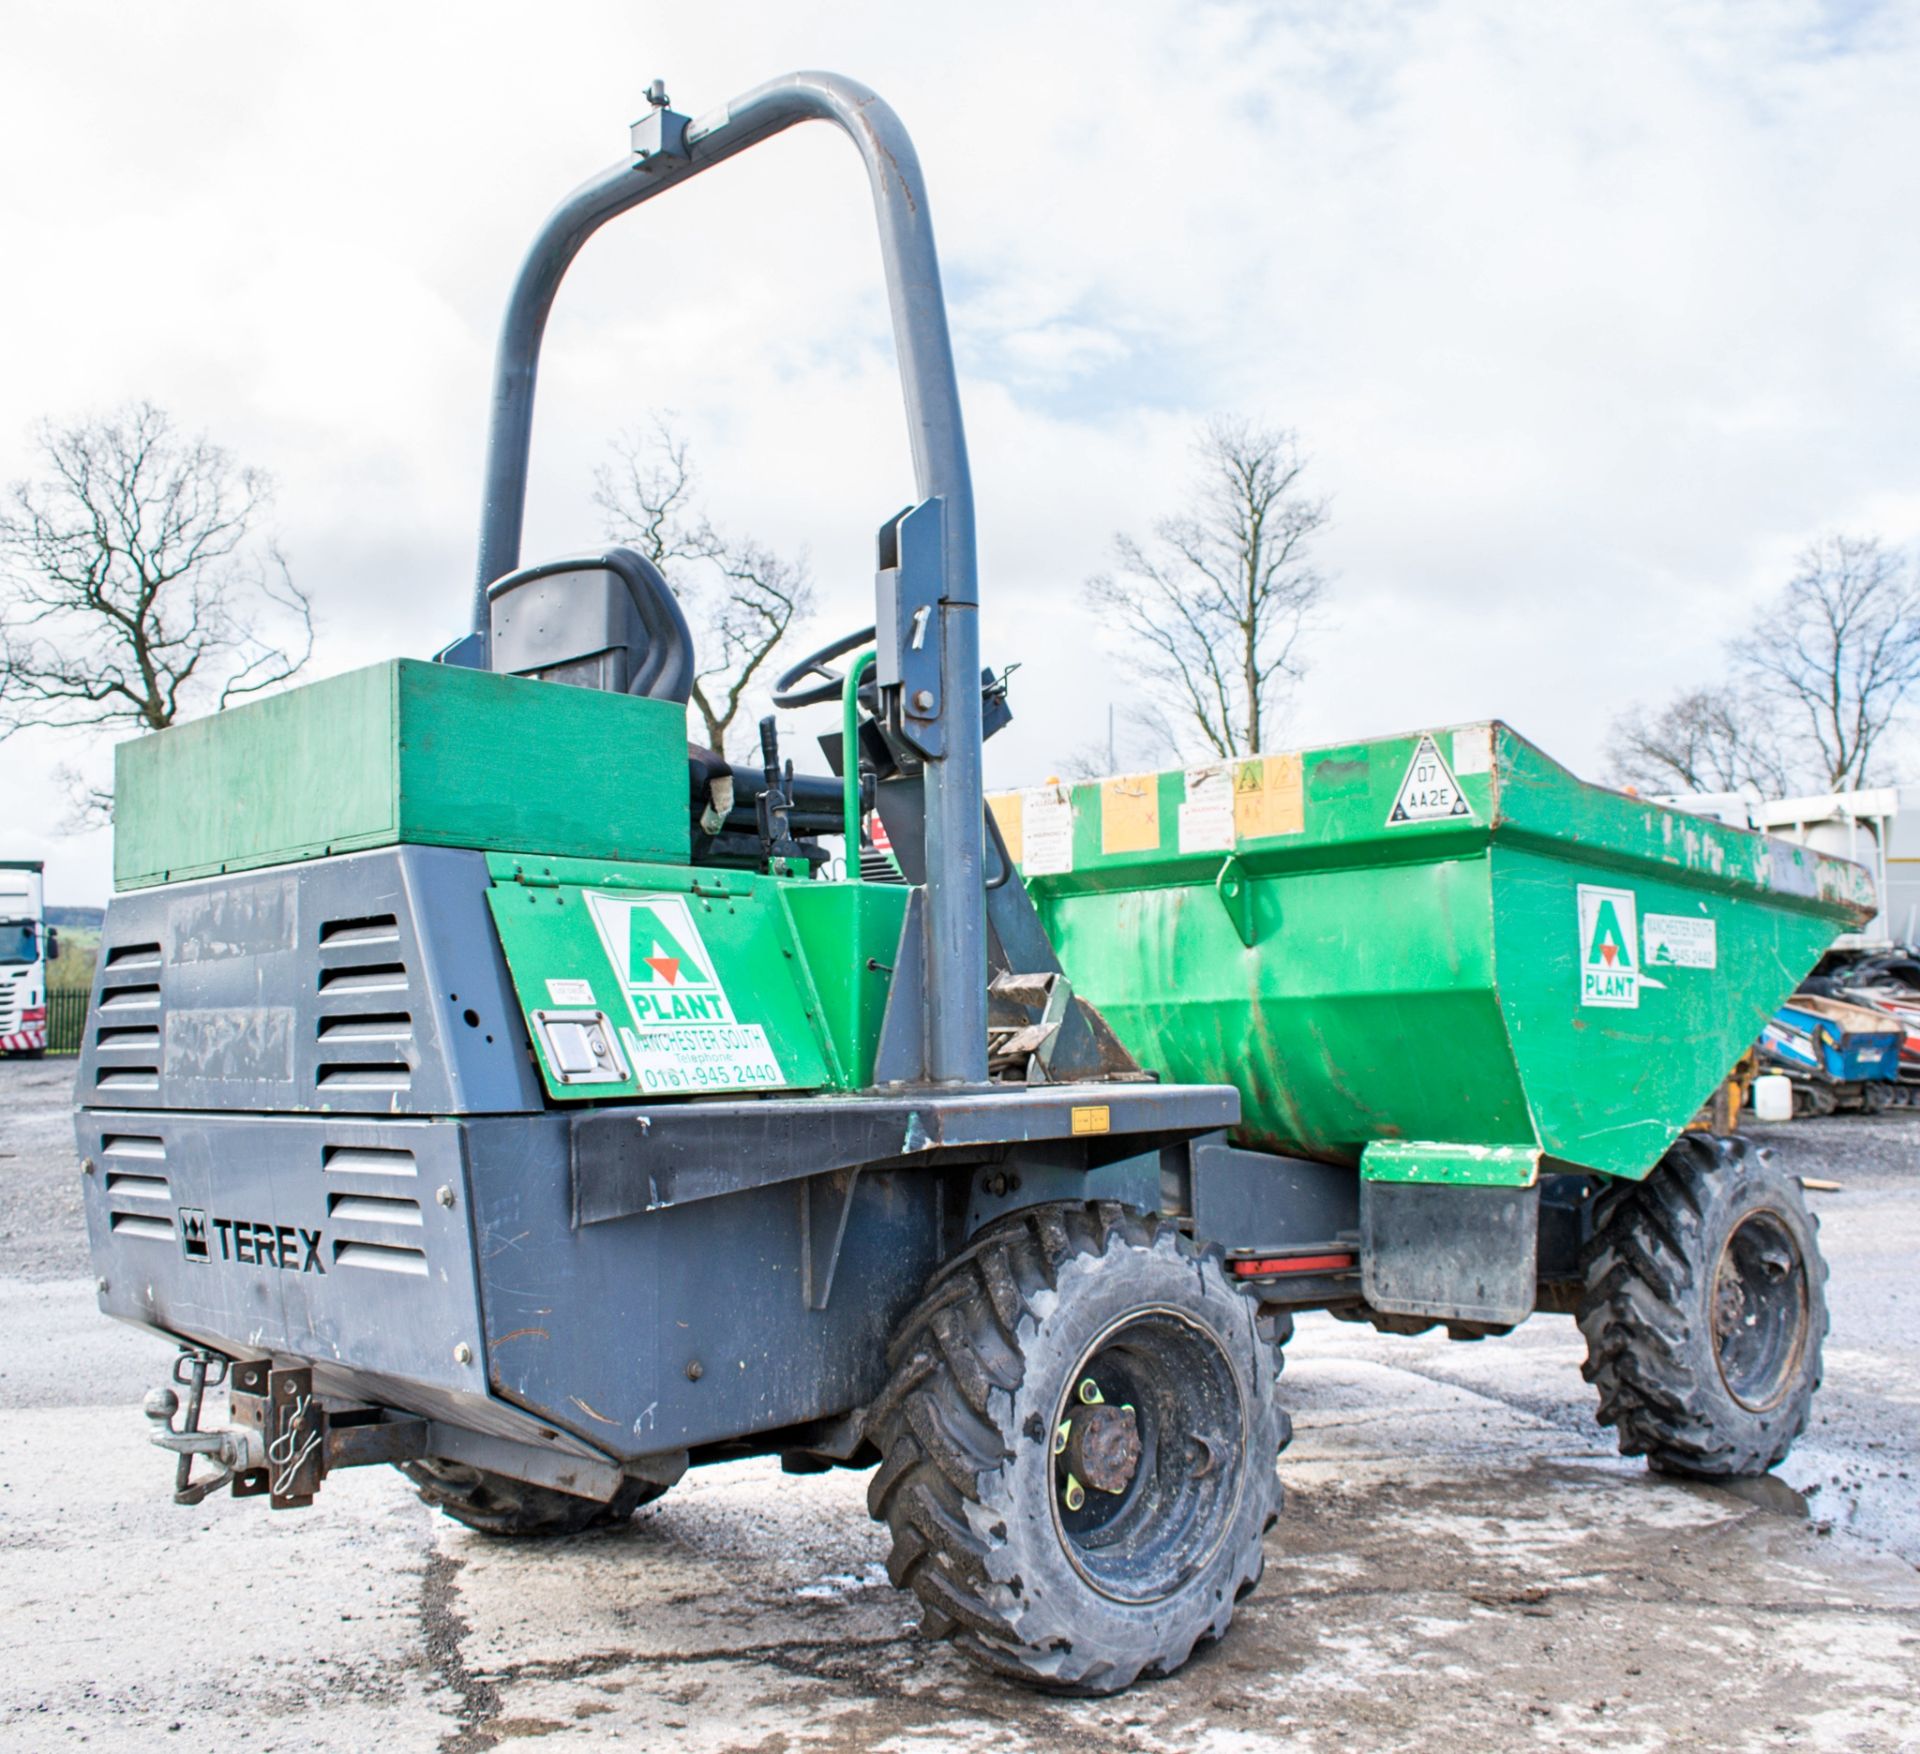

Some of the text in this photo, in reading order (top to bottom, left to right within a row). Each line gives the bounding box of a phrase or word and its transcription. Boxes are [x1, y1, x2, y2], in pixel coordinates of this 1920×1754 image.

[1409, 788, 1449, 808] AA2E
[629, 906, 710, 983] A
[1588, 900, 1632, 967] A
[1585, 974, 1635, 997] PLANT
[630, 994, 724, 1020] PLANT
[719, 1029, 765, 1050] SOUTH
[674, 1053, 734, 1064] Telephone
[644, 1063, 777, 1088] 0161-945 2440
[213, 1218, 326, 1274] TEREX
